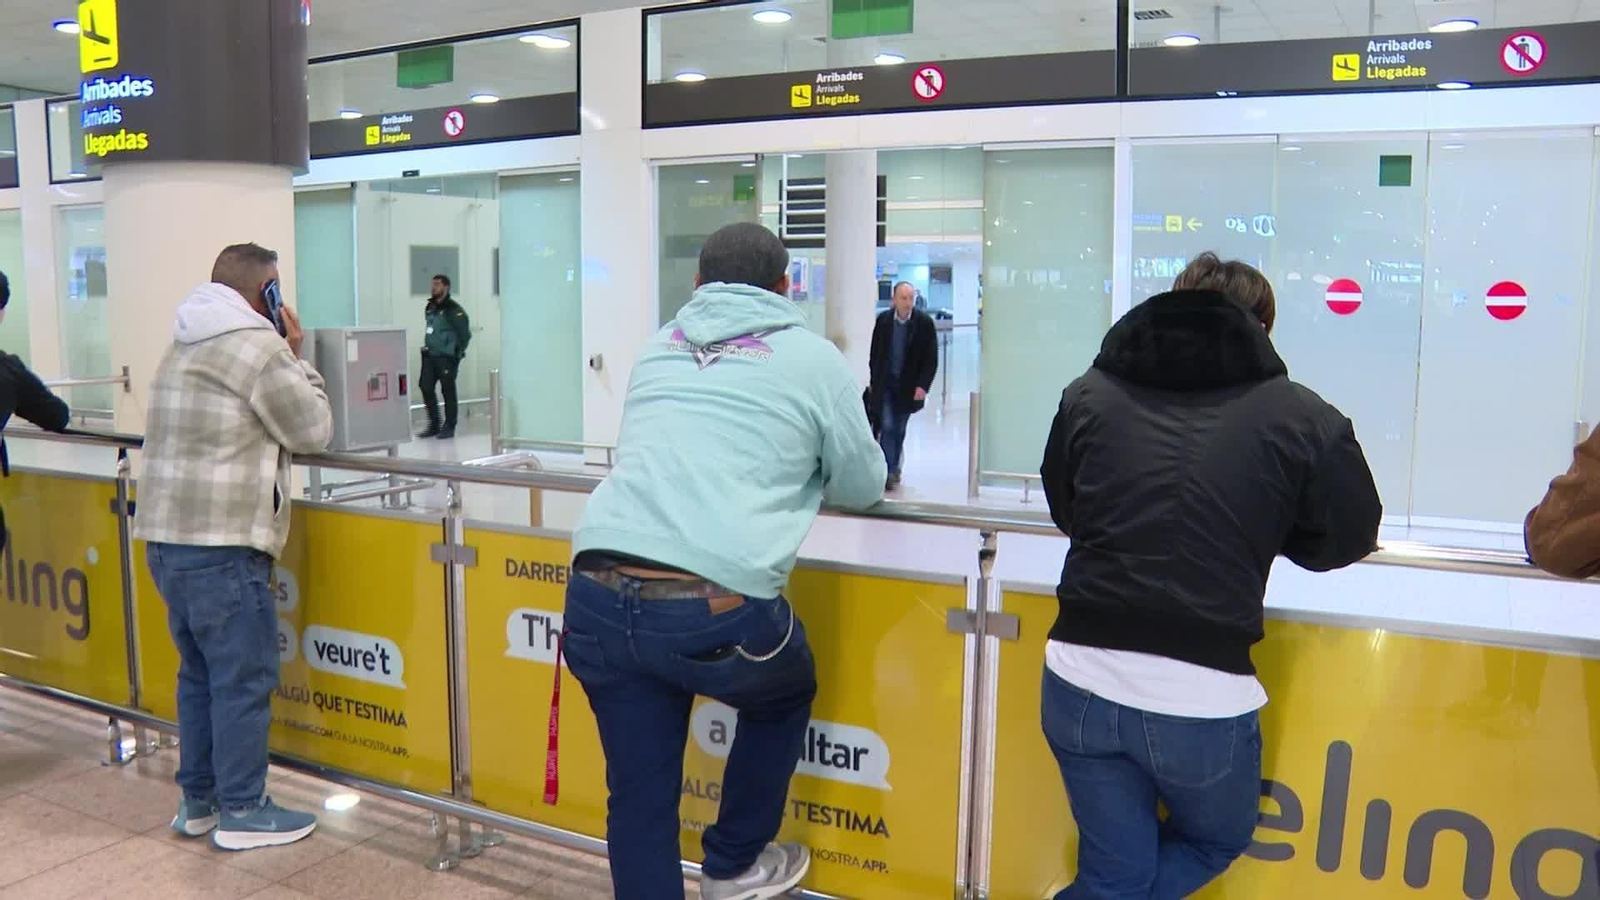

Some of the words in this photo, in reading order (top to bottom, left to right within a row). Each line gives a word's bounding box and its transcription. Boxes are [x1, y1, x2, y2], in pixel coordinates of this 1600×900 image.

[1367, 39, 1432, 52] Arribades
[1367, 54, 1406, 64] Arrivals
[816, 71, 864, 83] Arribades
[1367, 66, 1427, 80] Llegadas
[82, 75, 154, 103] Arribades
[816, 85, 845, 93] Arrivals
[816, 94, 860, 106] Llegadas
[84, 129, 148, 157] Llegadas
[522, 613, 563, 650] T'h
[314, 639, 391, 675] veure't
[313, 691, 343, 713] QUE
[801, 727, 869, 771] ltar
[681, 776, 721, 802] ALG
[791, 800, 890, 839] T'ESTIMA
[810, 846, 861, 868] NOSTRA
[861, 859, 889, 874] APP.
